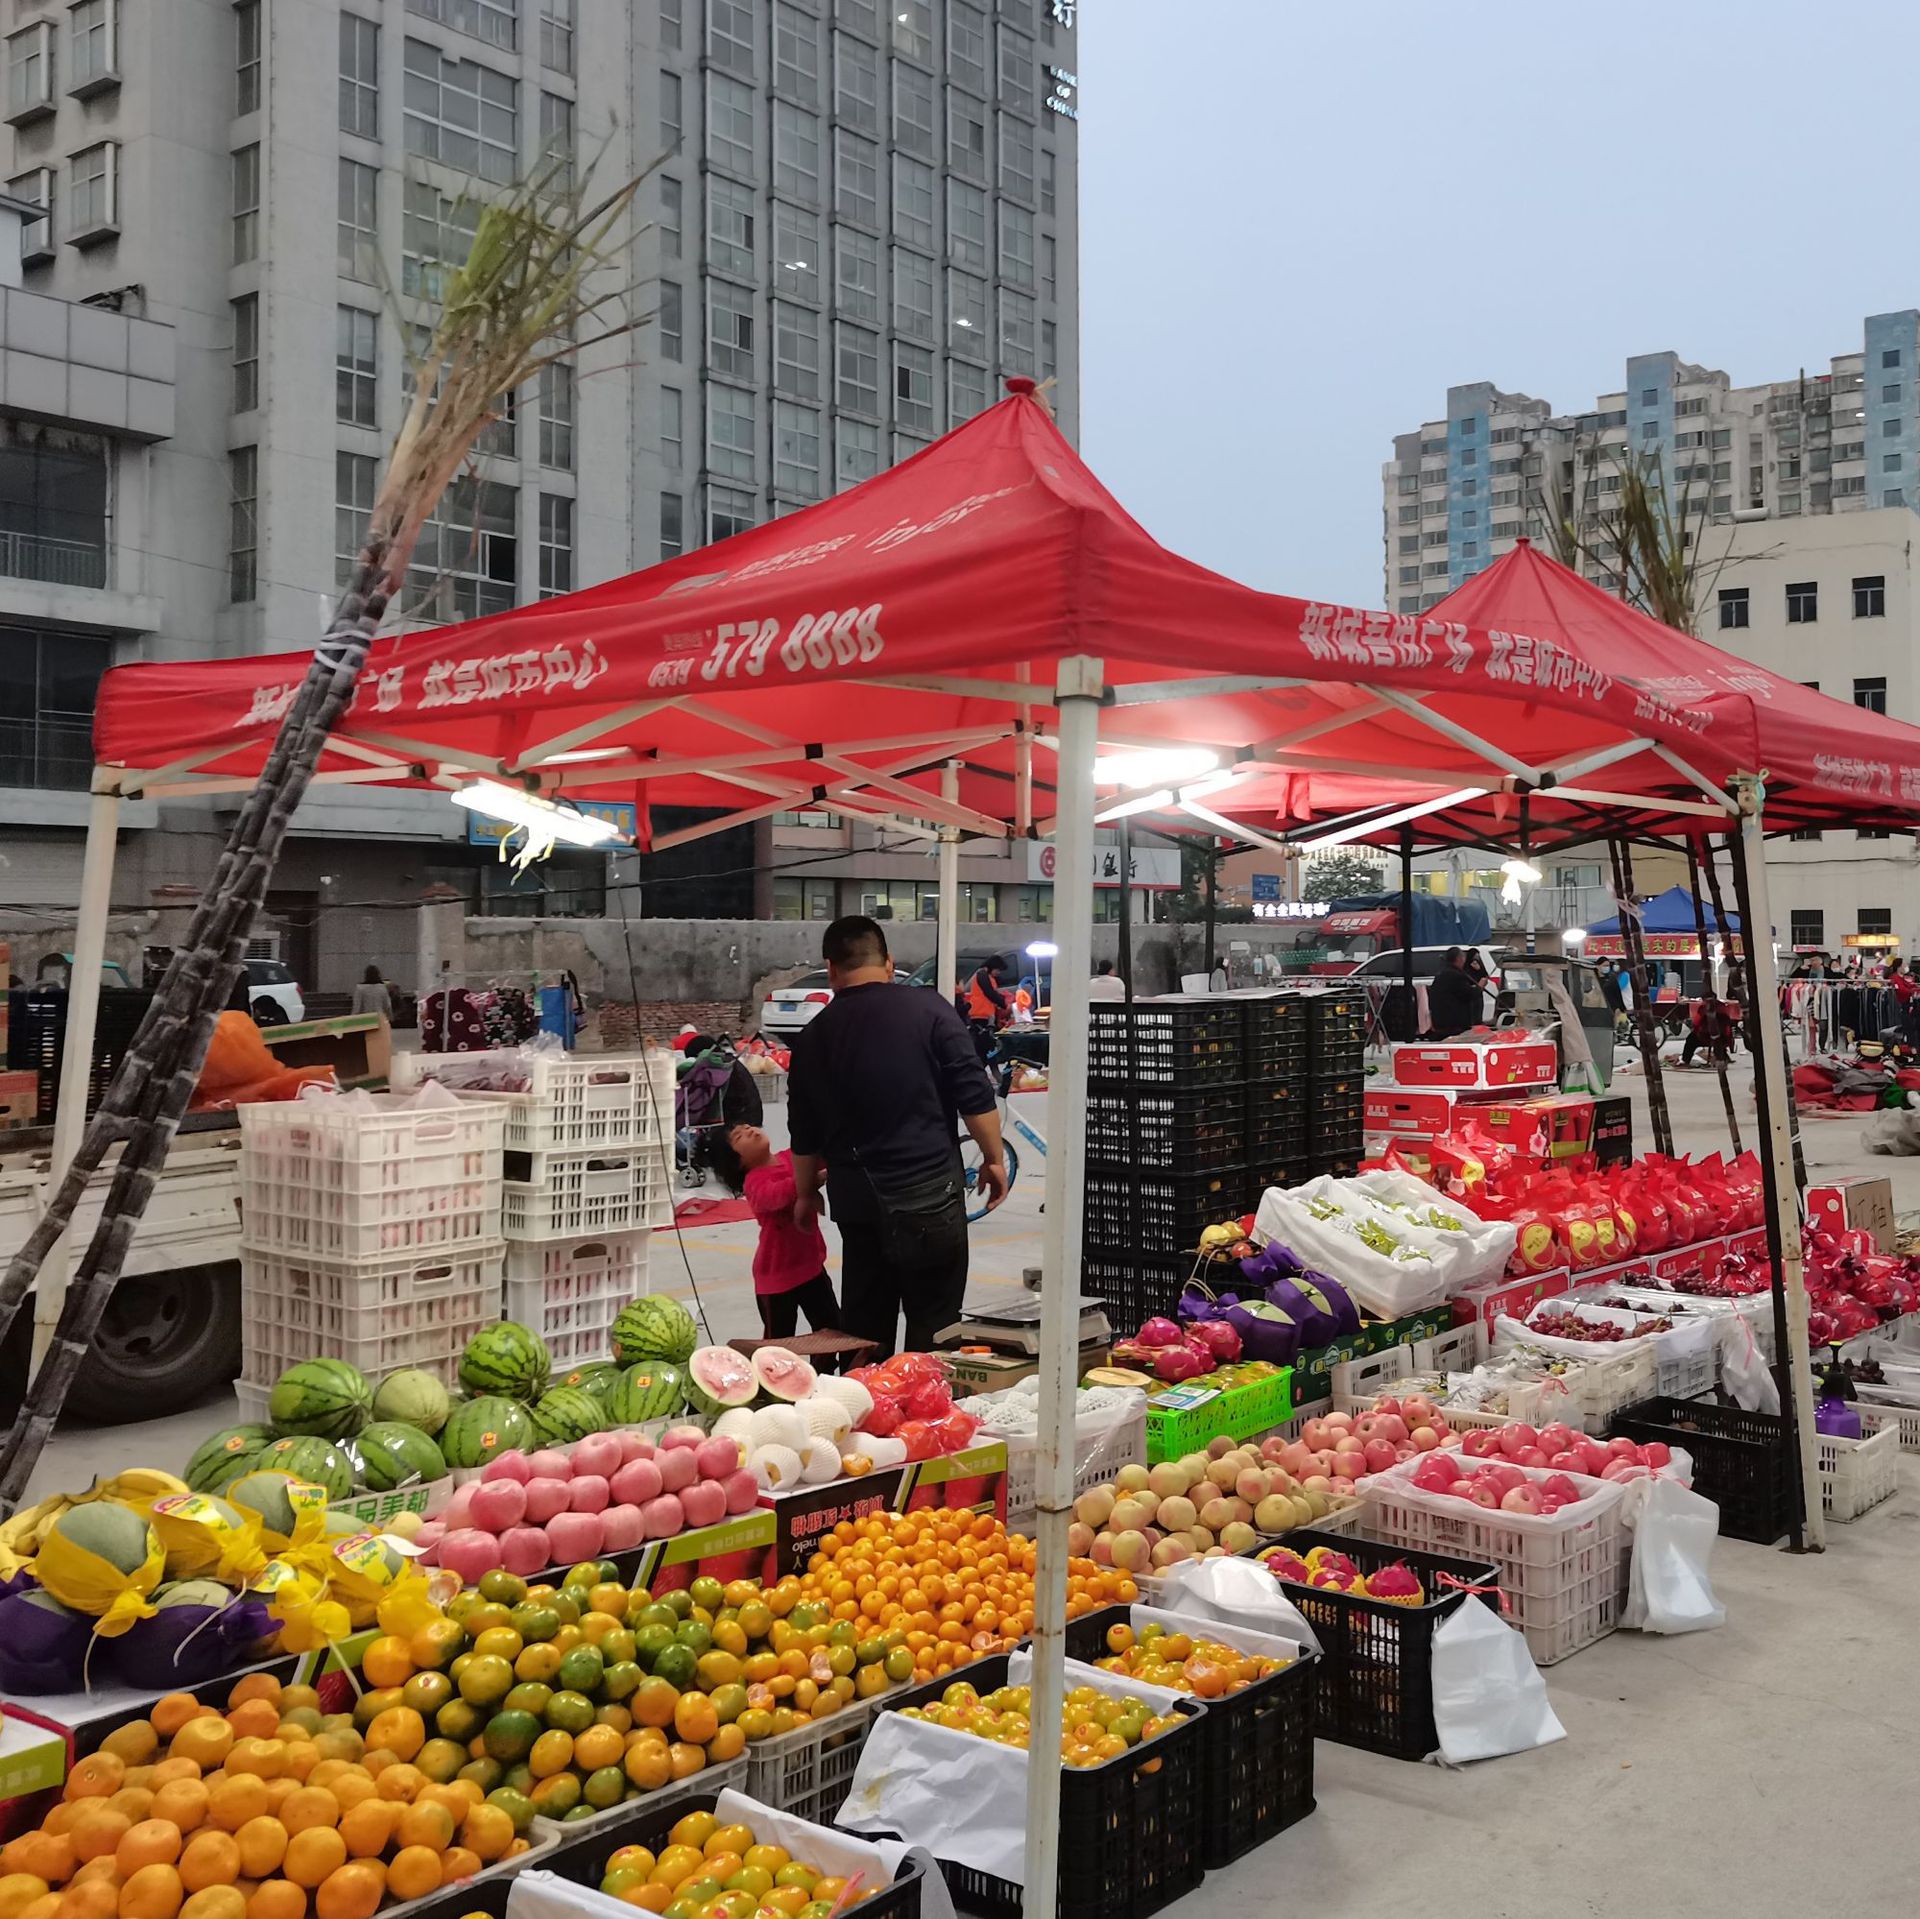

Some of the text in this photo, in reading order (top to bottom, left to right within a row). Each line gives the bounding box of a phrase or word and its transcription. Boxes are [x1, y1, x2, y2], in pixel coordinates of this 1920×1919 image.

[416, 638, 609, 710] 就是城市中心
[700, 617, 780, 681] 579
[780, 603, 884, 672] 8888
[1485, 629, 1613, 701] 就是城市中心
